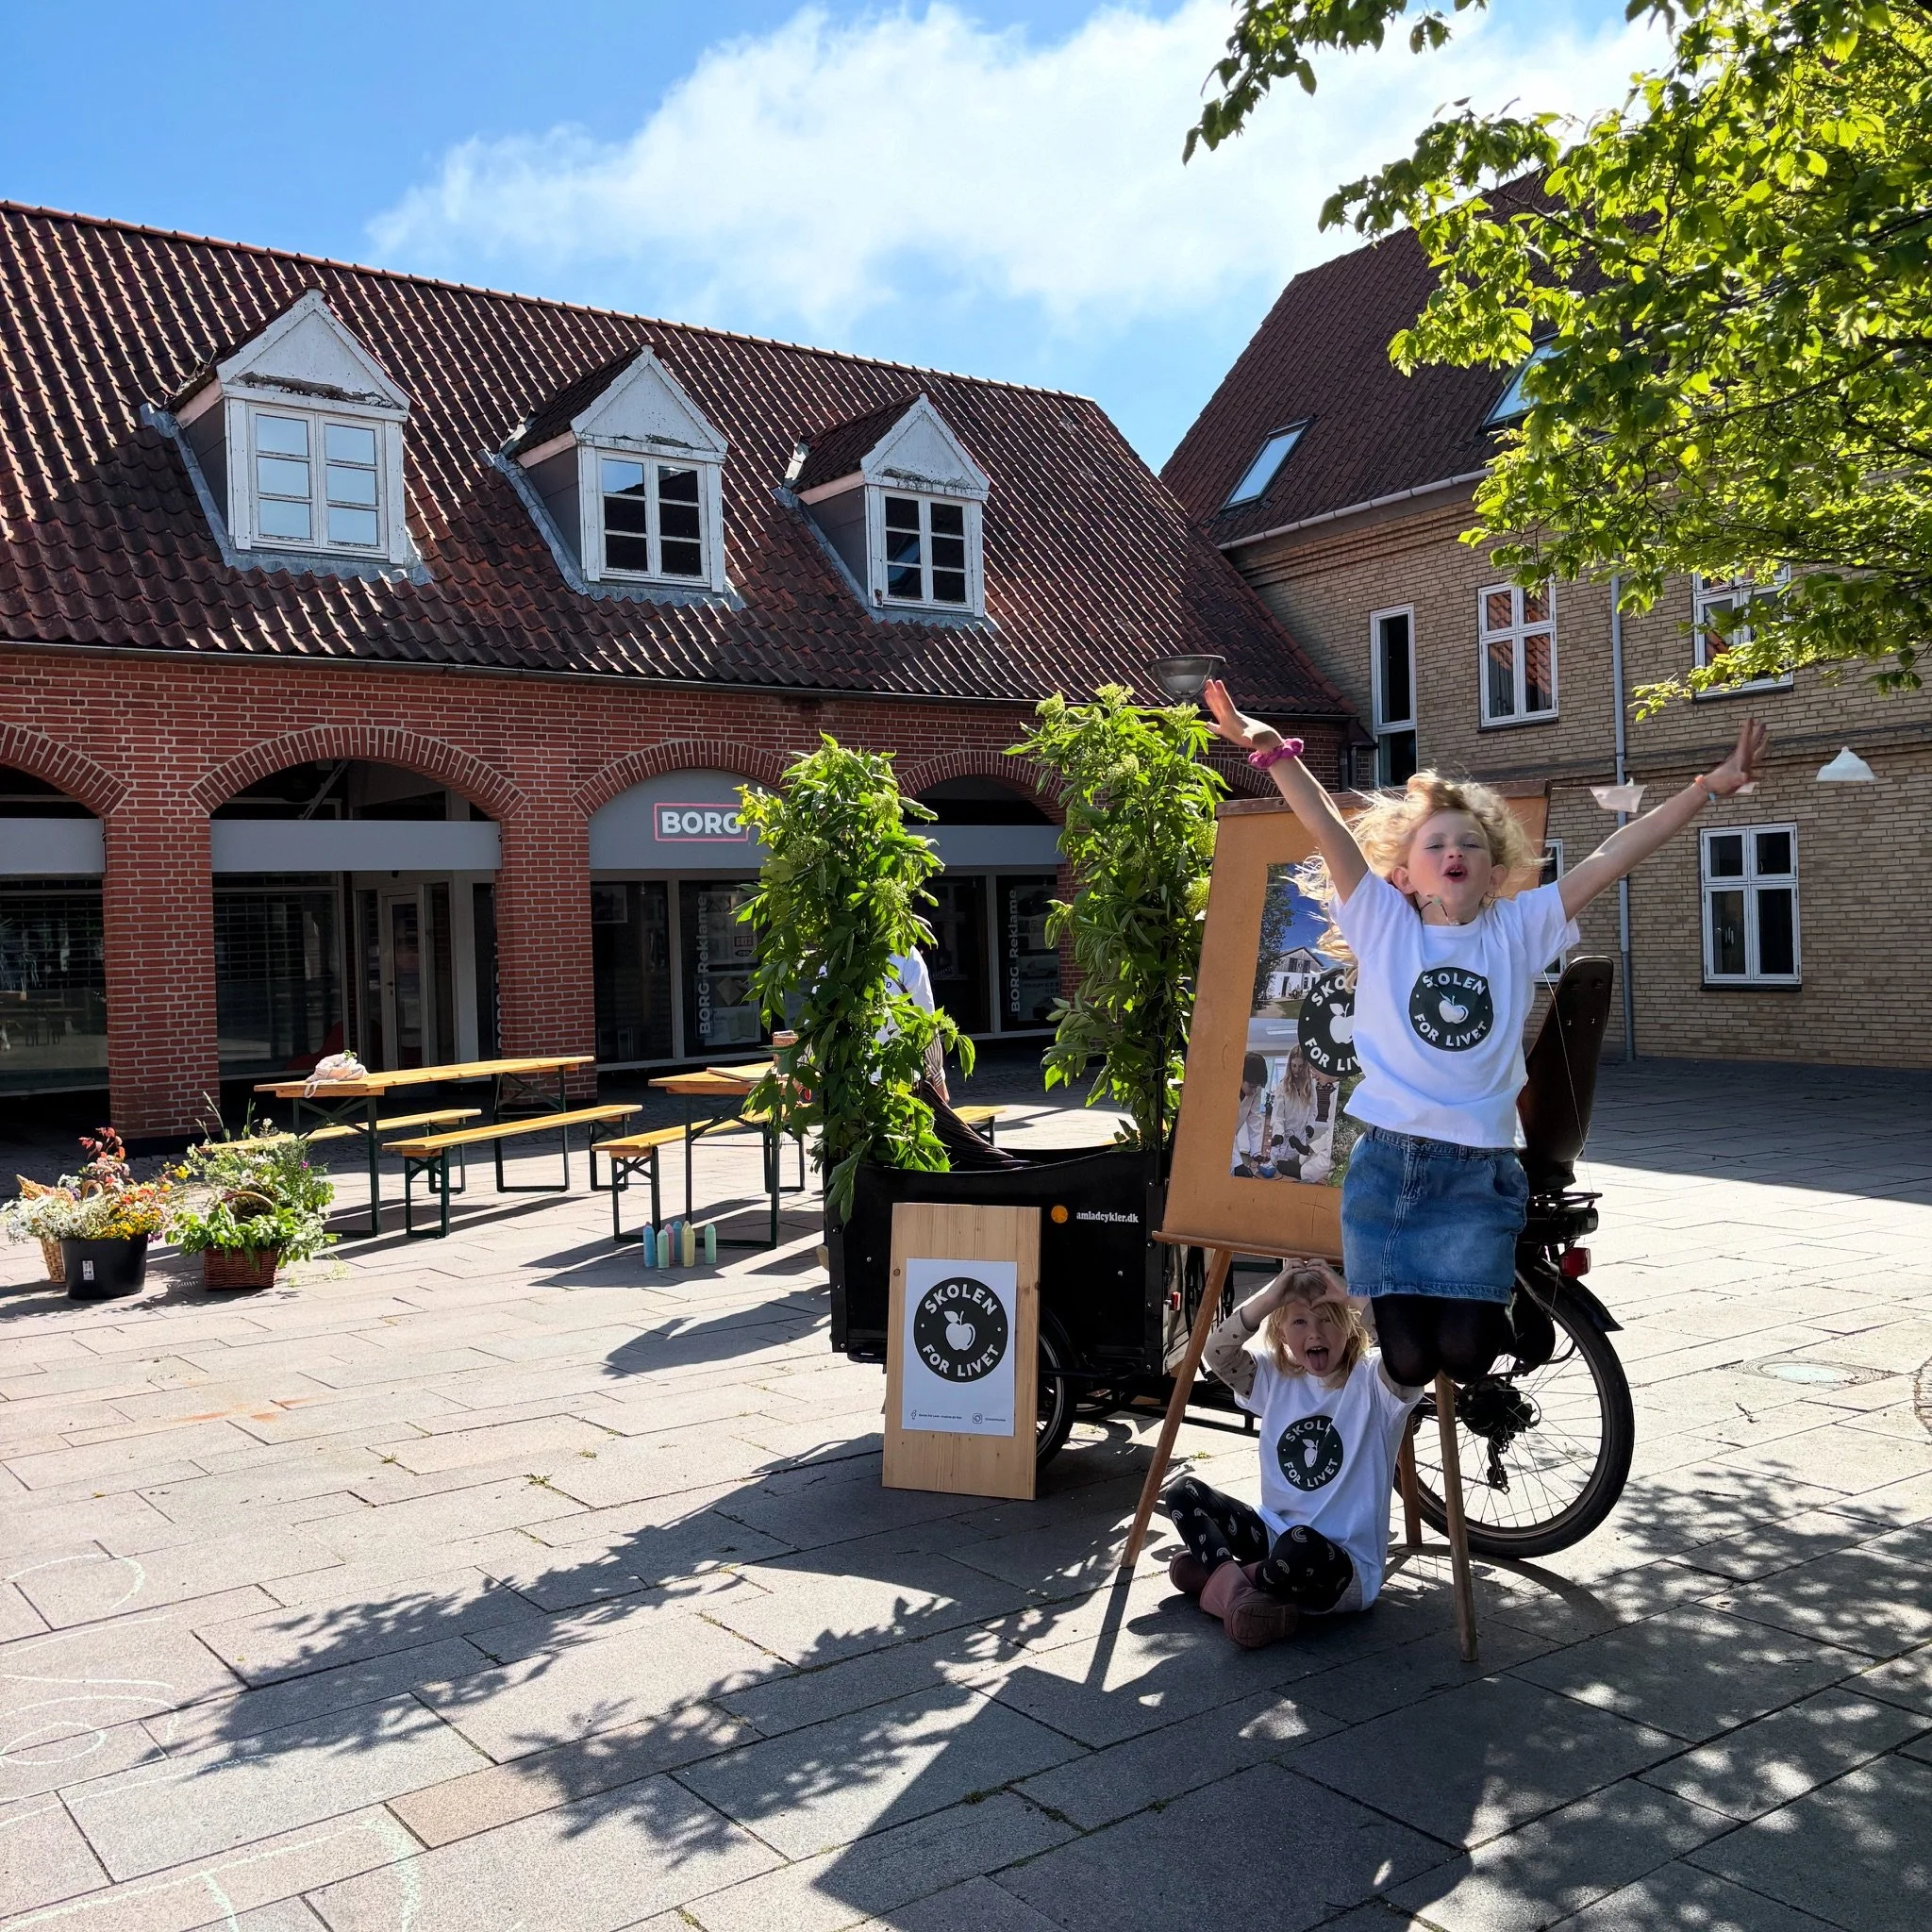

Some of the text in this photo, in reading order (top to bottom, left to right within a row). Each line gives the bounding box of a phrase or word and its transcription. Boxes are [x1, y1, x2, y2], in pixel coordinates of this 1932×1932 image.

[662, 811, 741, 834] BORG
[696, 896, 711, 1034] BORG Reklame
[1008, 889, 1021, 1012] BORG Reklame
[1423, 973, 1486, 995] SOLEN
[1414, 1013, 1487, 1047] FOR LIVET
[1305, 1037, 1362, 1072] FOR LIV
[1076, 1210, 1139, 1224] amladcykler.dk
[924, 1284, 998, 1316] SKOLEN
[923, 1343, 999, 1377] FOR LIVET
[1285, 1420, 1331, 1442] SKOL
[1284, 1457, 1338, 1488] FOR LIVET
